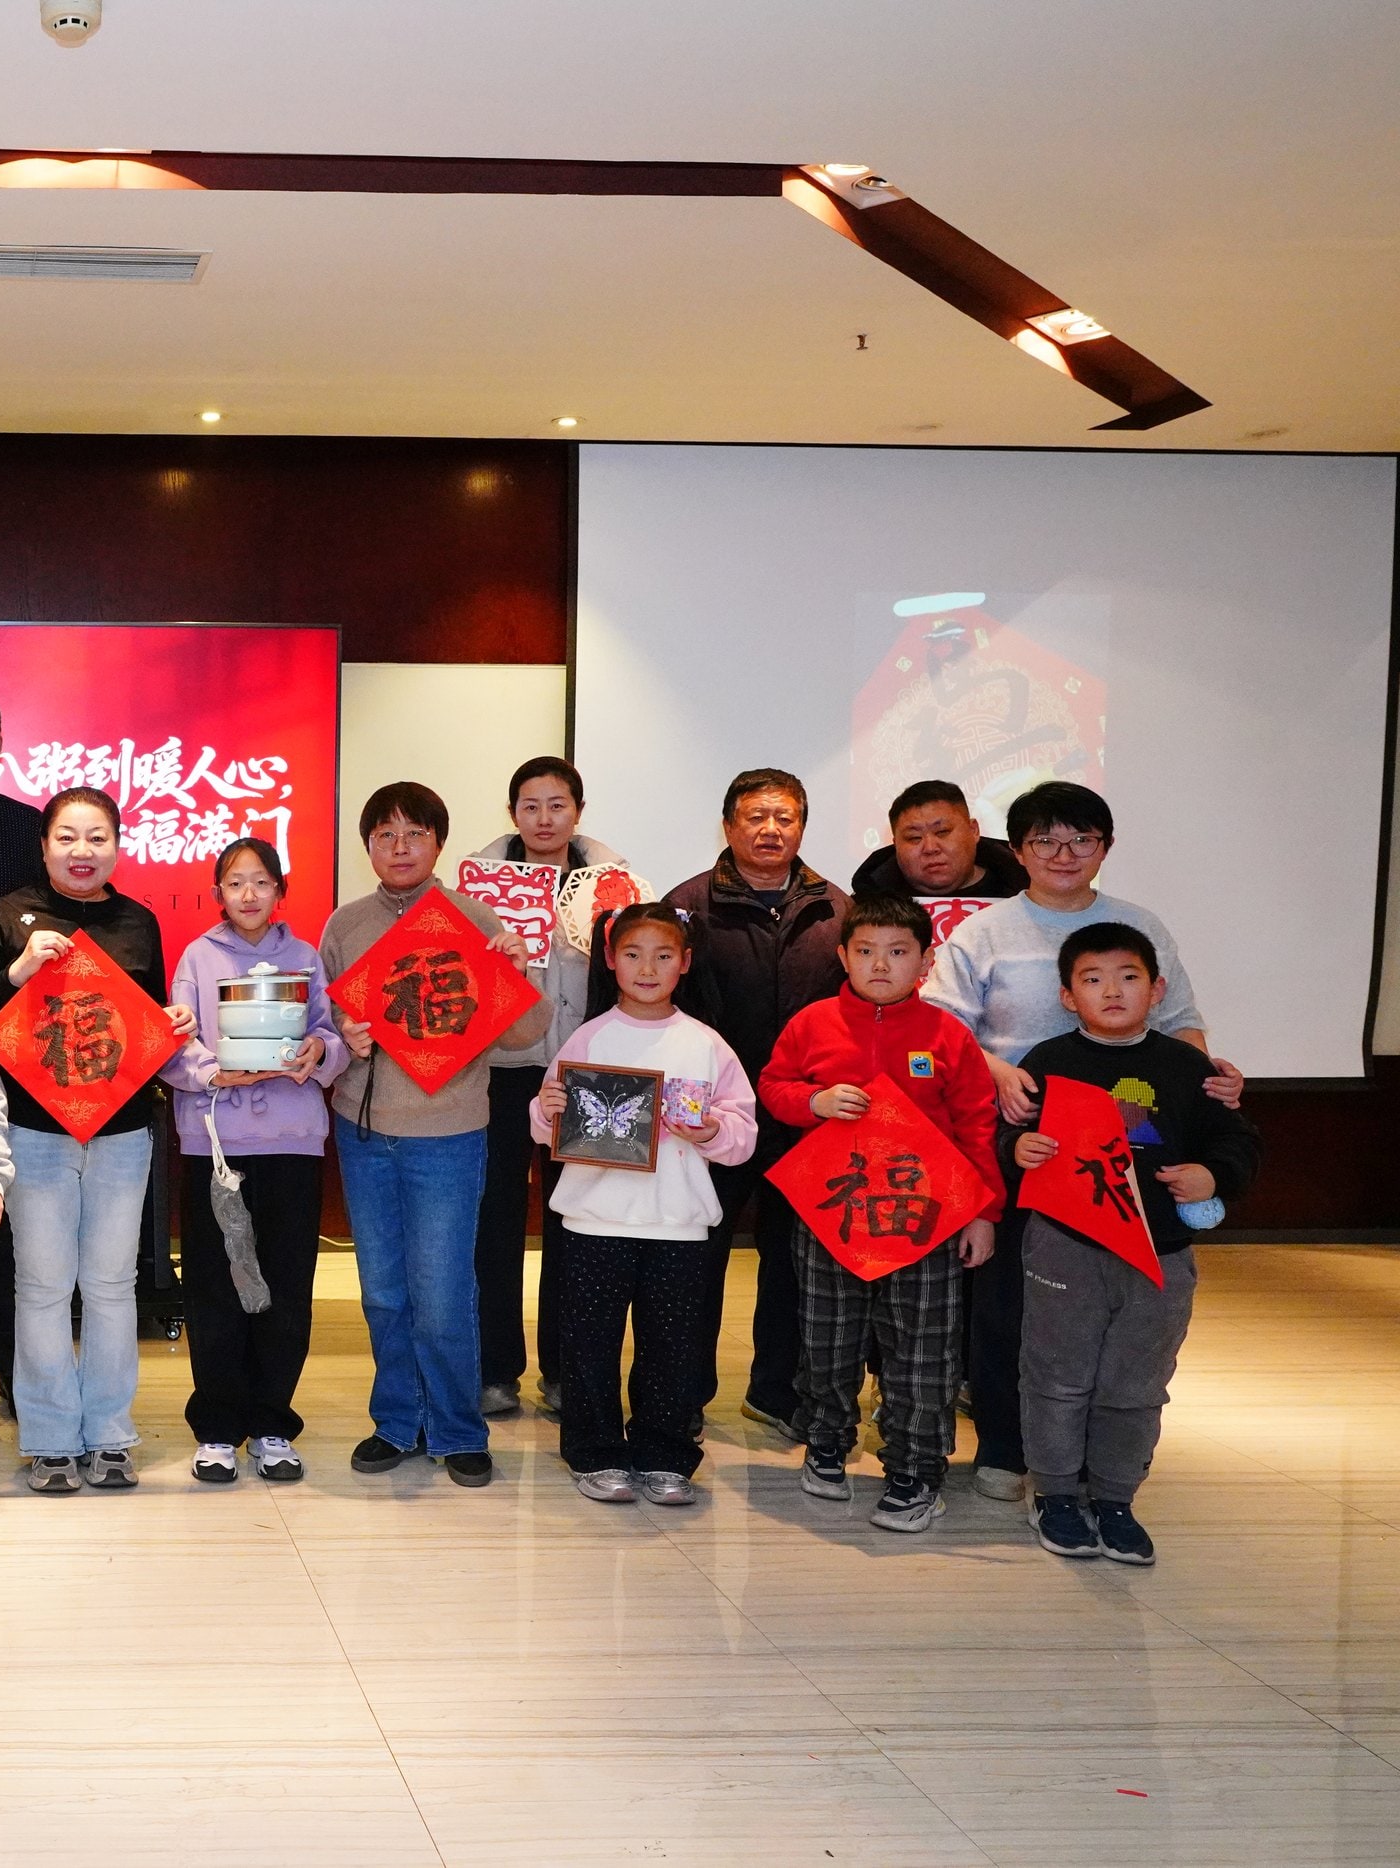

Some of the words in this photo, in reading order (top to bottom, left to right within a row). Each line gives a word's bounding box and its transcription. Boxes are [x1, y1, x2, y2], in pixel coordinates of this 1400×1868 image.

[118, 803, 293, 876] 福满门
[34, 993, 123, 1088] 福
[382, 950, 479, 1040] 福
[814, 1151, 942, 1247] 福
